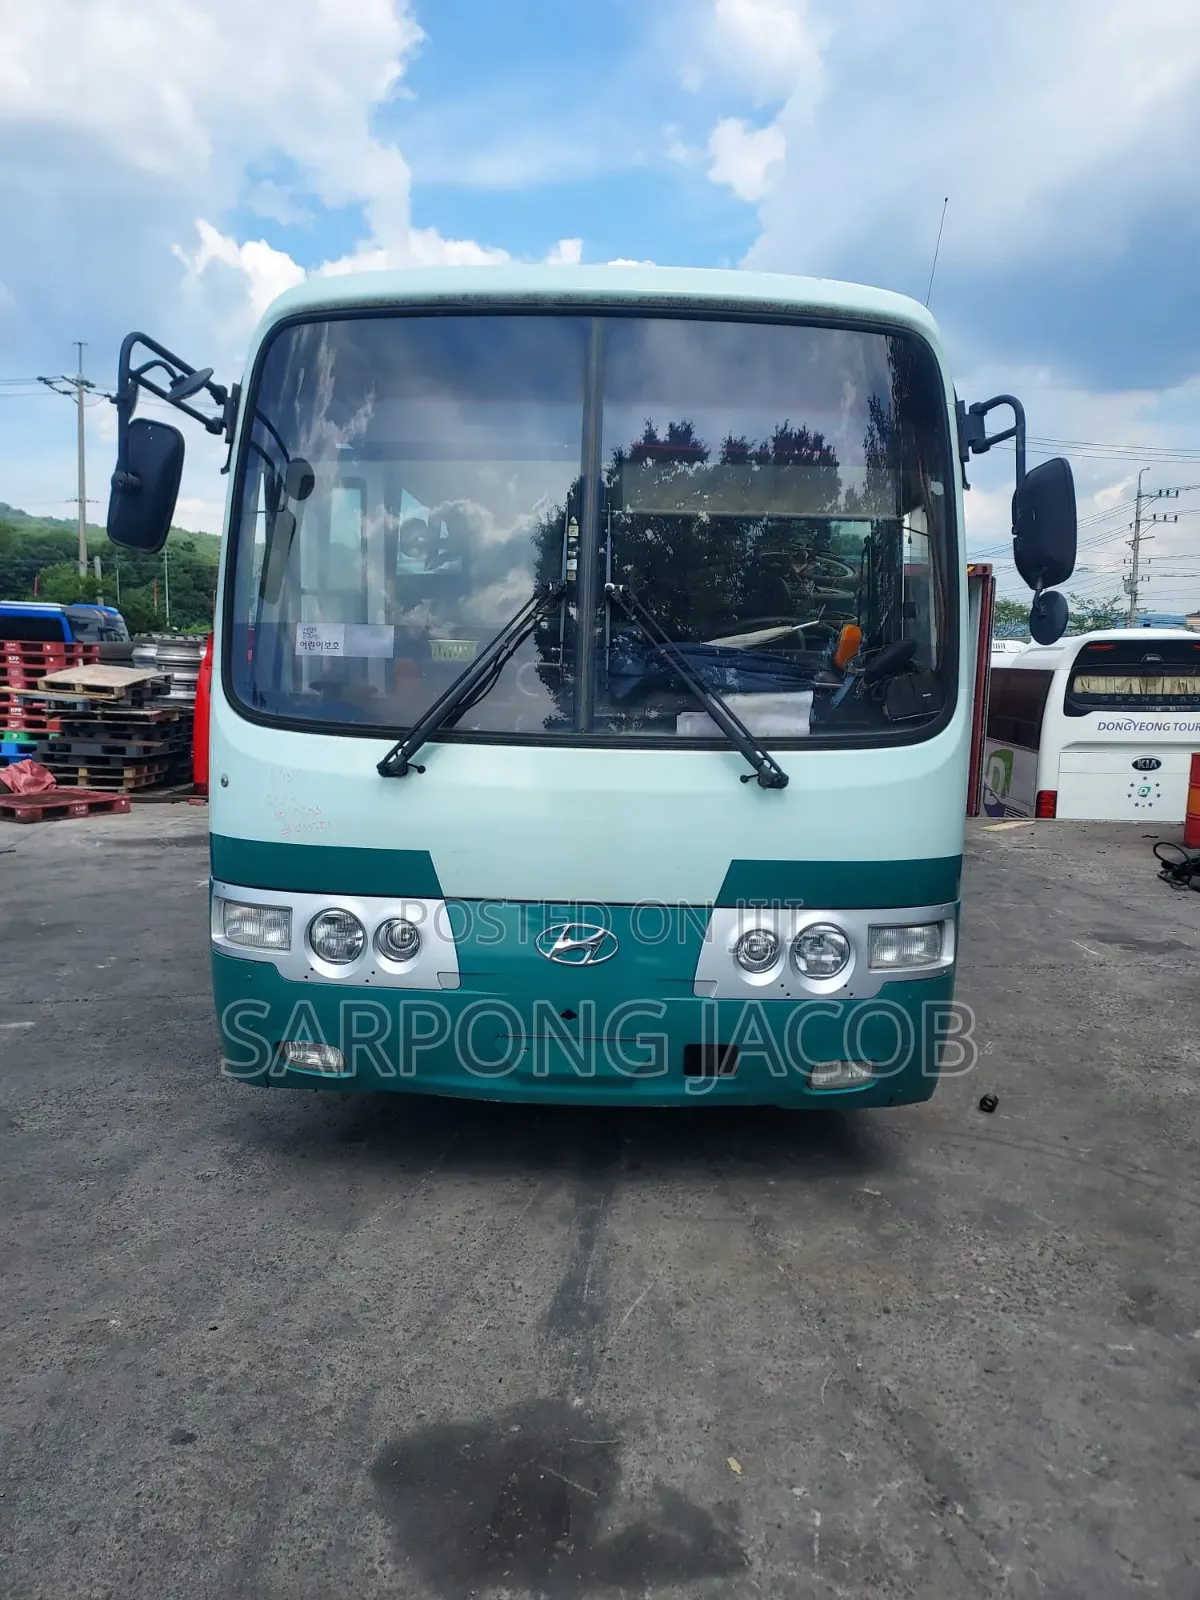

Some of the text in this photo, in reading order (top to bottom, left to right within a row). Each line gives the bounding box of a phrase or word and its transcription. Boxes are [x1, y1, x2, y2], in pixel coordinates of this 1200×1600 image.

[300, 641, 339, 650] 어린이보호
[1098, 721, 1170, 731] DONGYEONG
[1137, 759, 1158, 769] KIA
